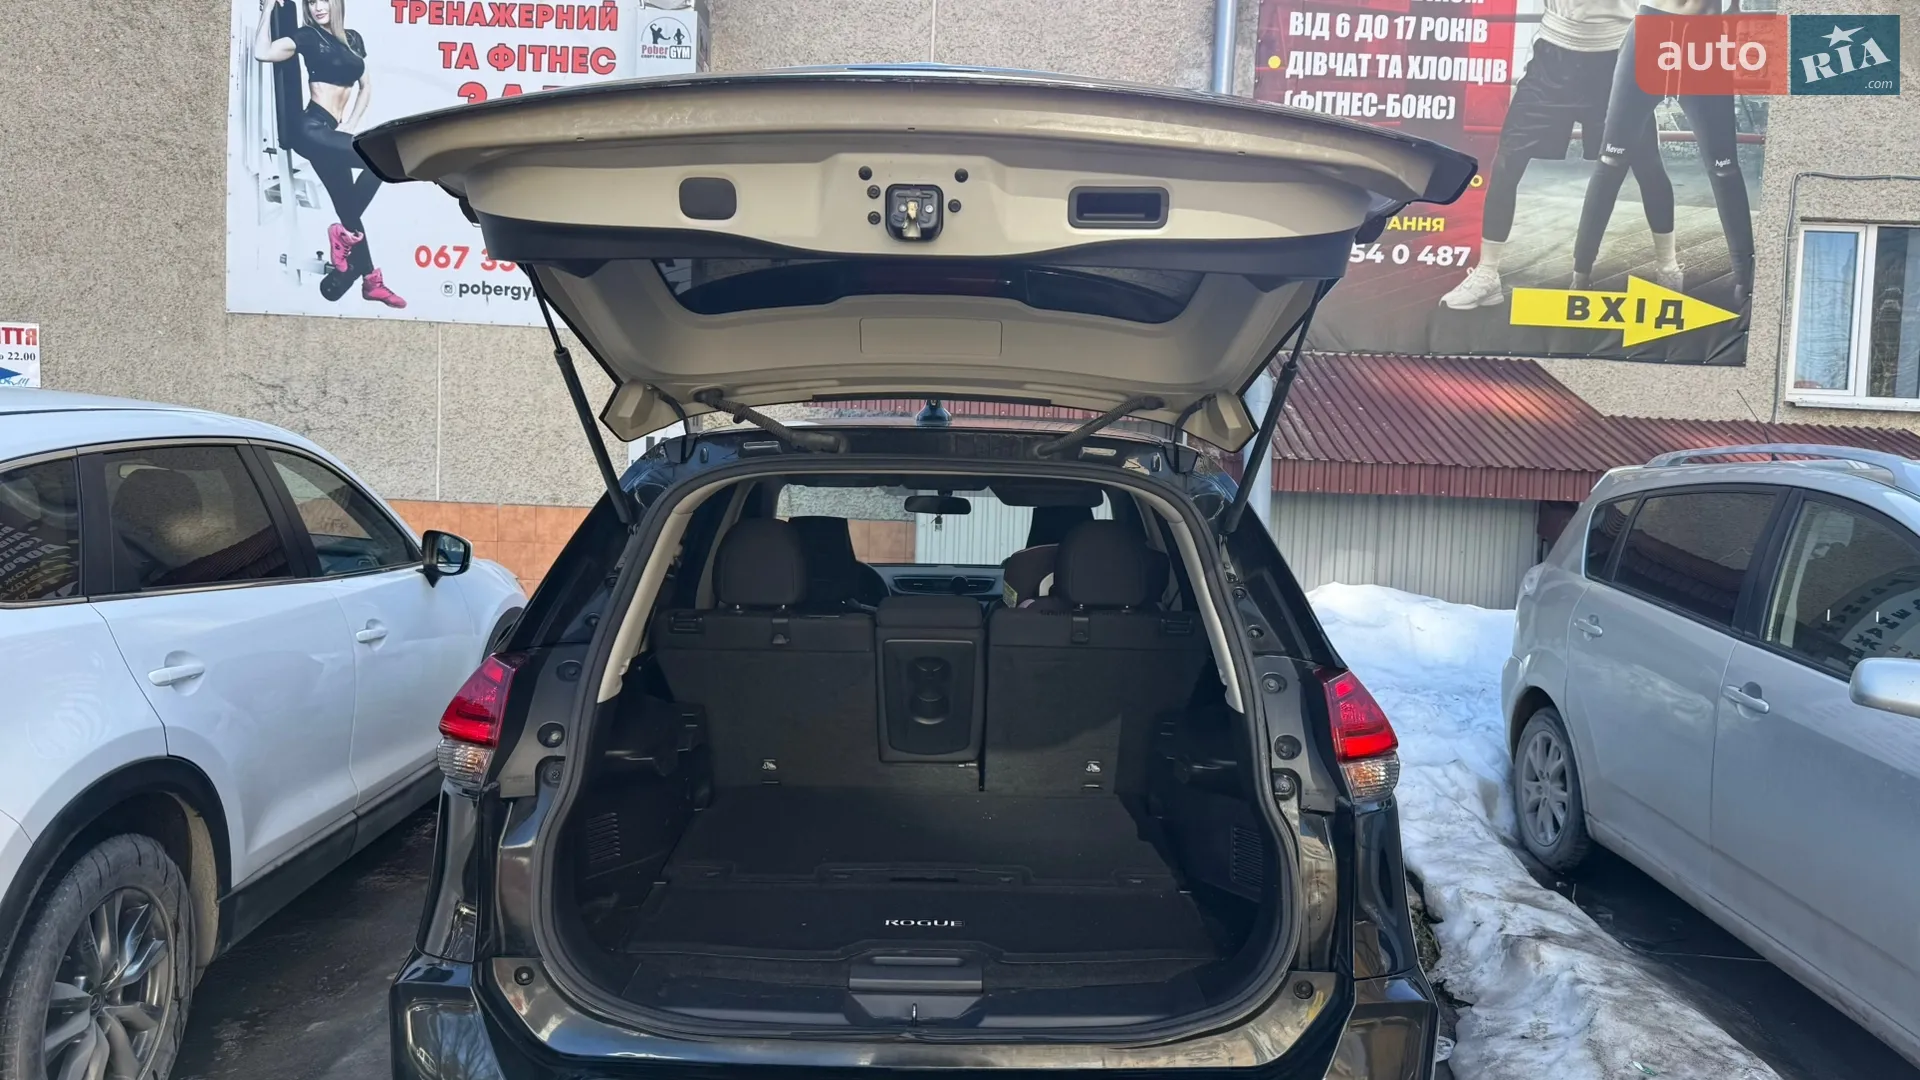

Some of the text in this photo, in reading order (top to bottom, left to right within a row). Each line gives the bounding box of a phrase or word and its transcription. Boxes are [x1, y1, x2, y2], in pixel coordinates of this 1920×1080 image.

[391, 0, 618, 31] ТРЕНАЖЕРНИЙ
[1289, 11, 1488, 43] ВІД 6 ДО 17 РОКІВ
[438, 41, 616, 75] ТА ФІТНЕС
[1285, 51, 1508, 85] ДІВЧАТ ТА ХЛОПЦІВ
[1387, 216, 1445, 232] АННЯ
[414, 245, 470, 269] 067
[1391, 244, 1410, 265] 0
[1417, 244, 1472, 267] 487
[459, 281, 536, 301] pobergy
[1566, 295, 1684, 330] ВХІД
[0, 326, 37, 346] ТТЯ
[8, 352, 36, 361] 22.00
[885, 919, 963, 927] ROGUE
